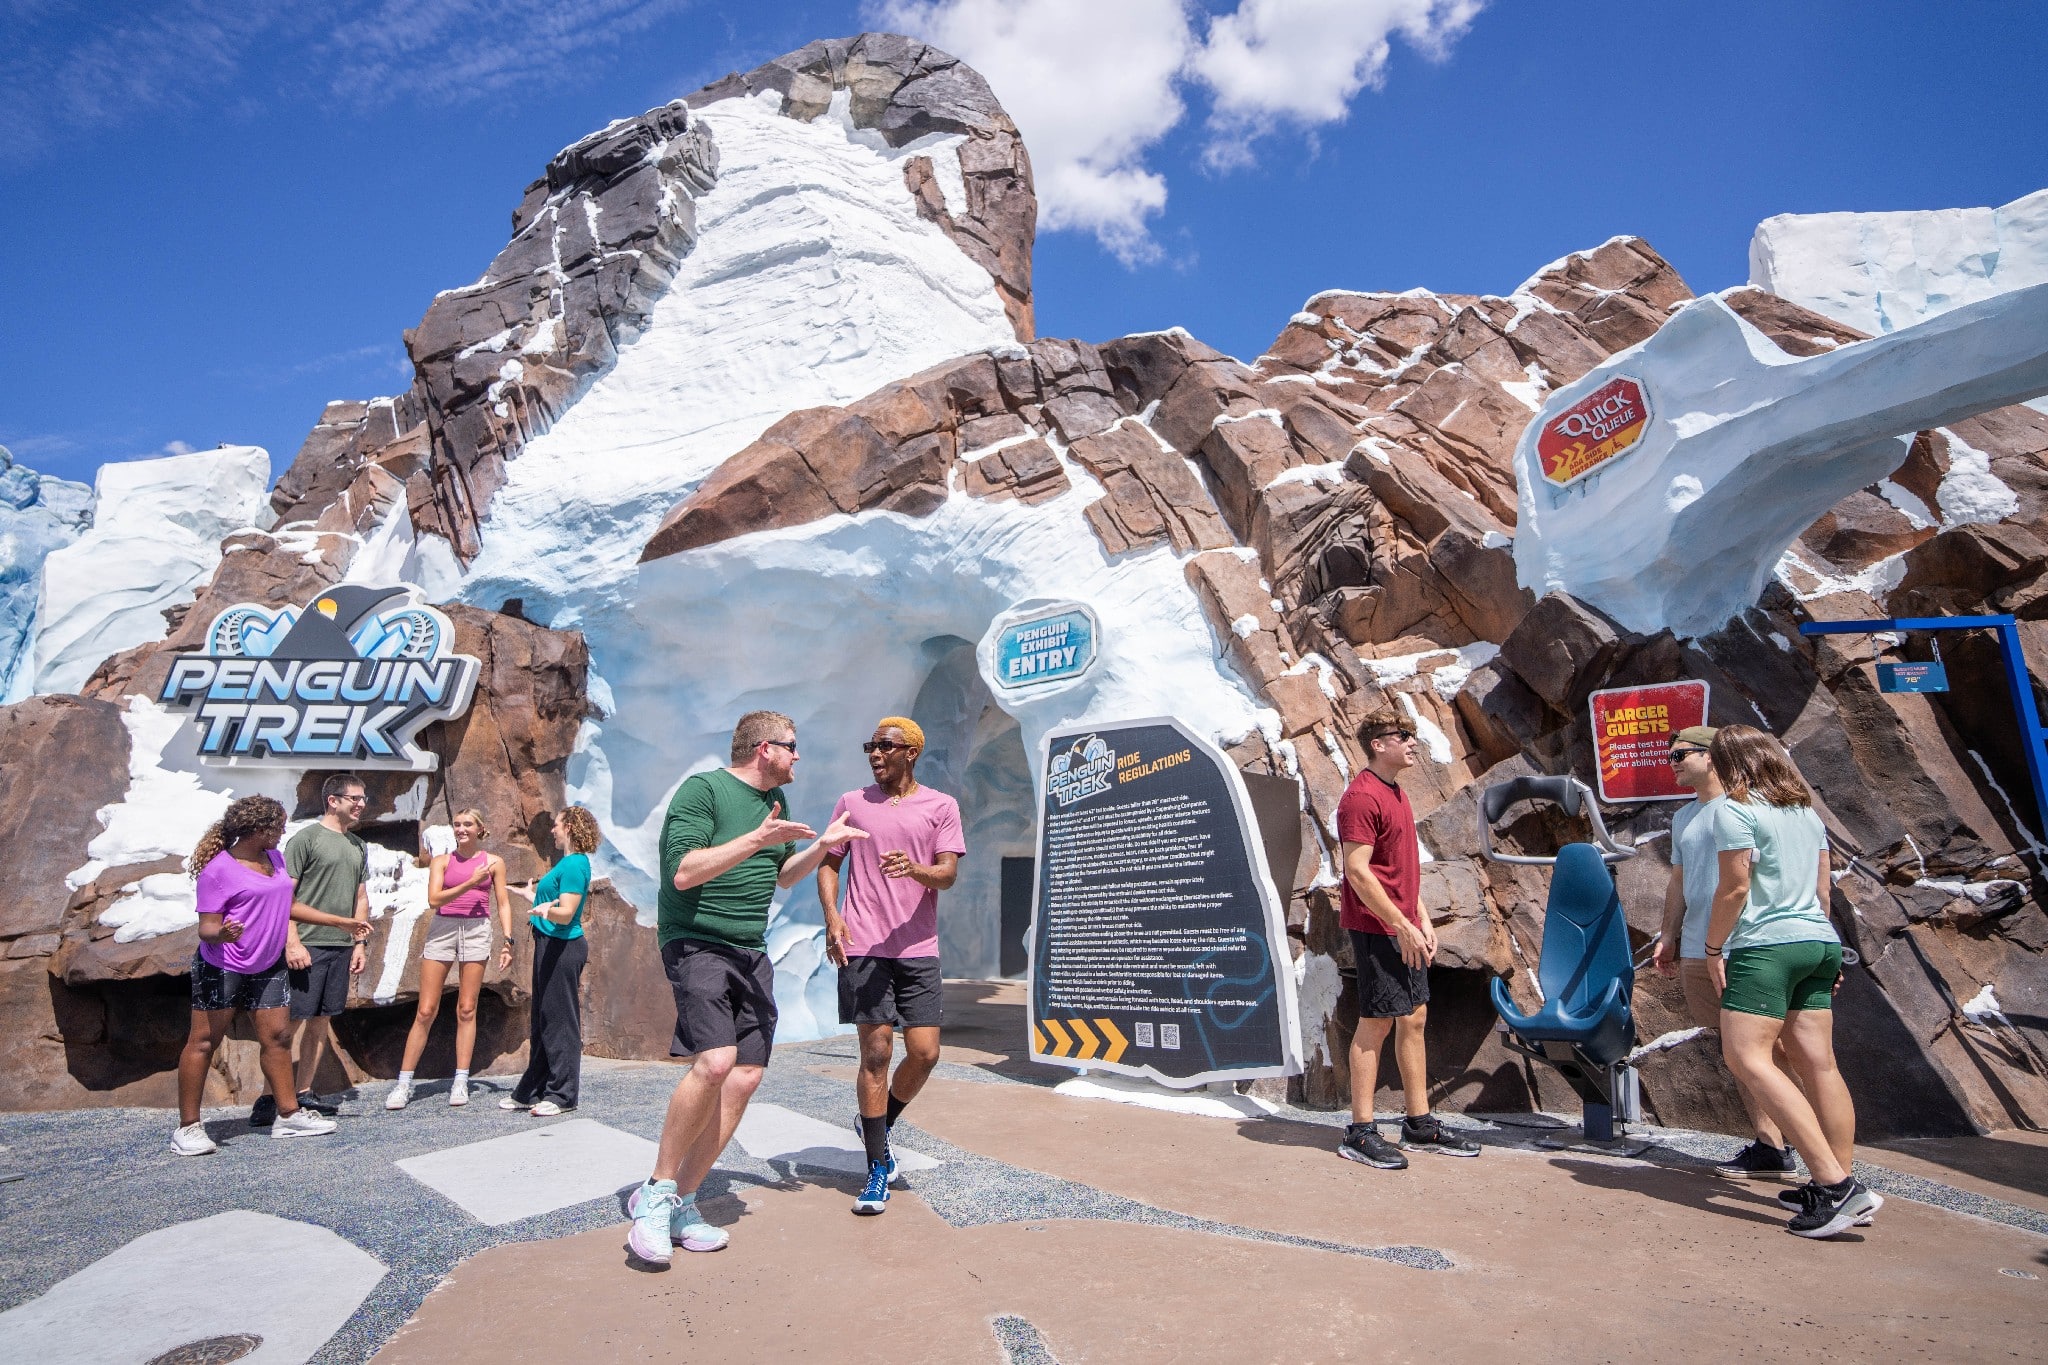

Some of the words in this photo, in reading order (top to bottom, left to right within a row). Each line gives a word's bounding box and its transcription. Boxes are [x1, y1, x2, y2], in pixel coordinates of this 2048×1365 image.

[1560, 390, 1632, 437] QUICK
[1591, 407, 1636, 441] QUEUE
[1569, 457, 1585, 471] ADA
[1584, 447, 1603, 461] RIDE
[1571, 451, 1609, 478] ENTRANCE
[1016, 621, 1071, 644] PENGUIN
[1021, 634, 1068, 655] EXHIBIT
[1009, 646, 1077, 678] ENTRY
[161, 659, 453, 702] PENGUIN
[1604, 704, 1669, 723] LARGER
[200, 703, 408, 755] TREK
[1606, 719, 1670, 737] GUESTS
[1609, 742, 1636, 751] Please
[1637, 740, 1654, 749] test
[1655, 739, 1669, 747] the
[1610, 752, 1628, 760] seat
[1629, 751, 1639, 759] to
[1049, 753, 1114, 792] PENGUIN
[1116, 751, 1141, 770] RIDE
[1118, 749, 1192, 784] REGULATIONS
[1611, 761, 1629, 770] your
[1631, 759, 1657, 768] ability
[1658, 758, 1668, 766] to
[1059, 771, 1107, 803] TREK
